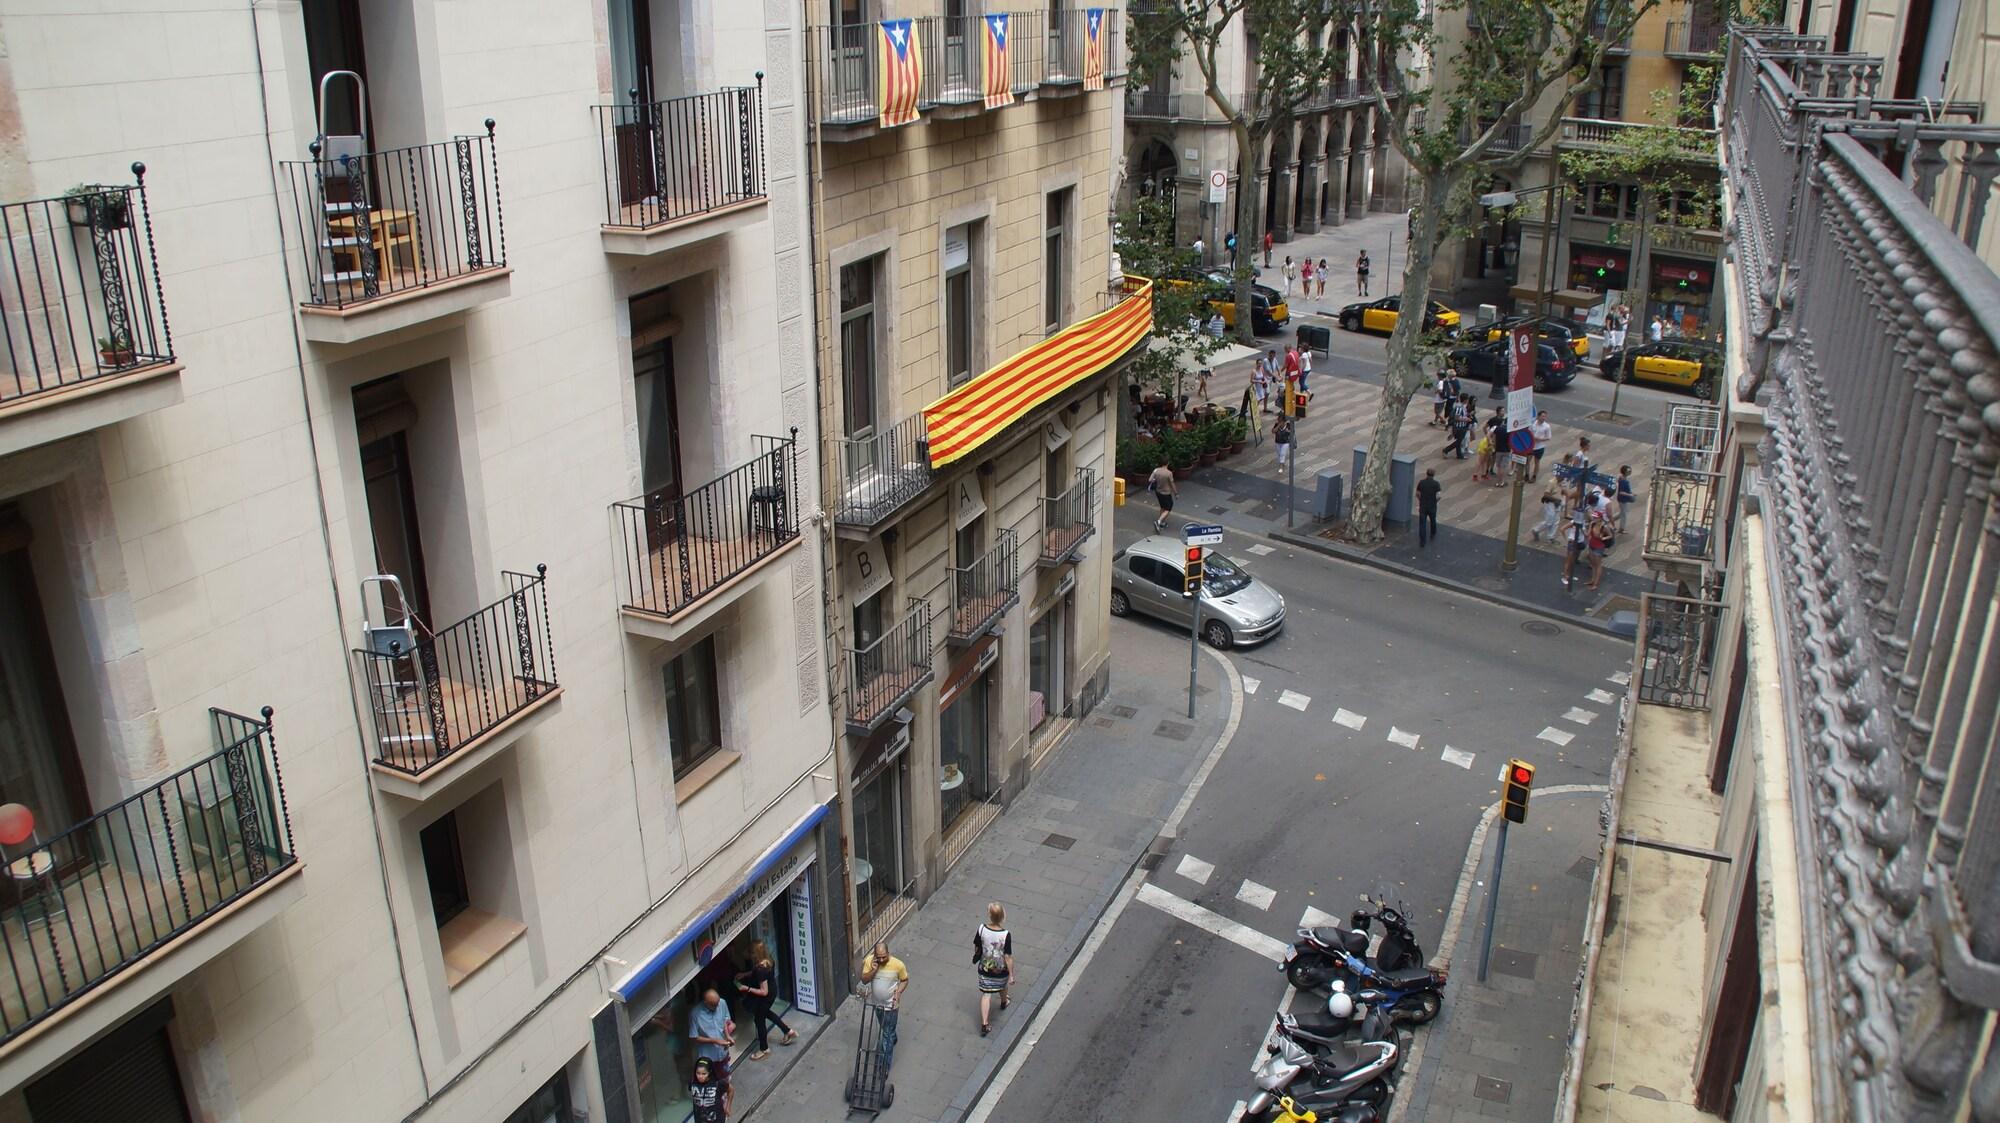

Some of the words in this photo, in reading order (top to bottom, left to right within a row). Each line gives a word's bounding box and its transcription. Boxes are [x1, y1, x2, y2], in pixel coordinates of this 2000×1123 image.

[960, 482, 971, 508] A
[857, 551, 872, 579] B
[717, 896, 756, 938] Apuestas
[757, 879, 770, 898] del
[771, 855, 798, 885] Estado
[797, 911, 808, 974] VENDIDO
